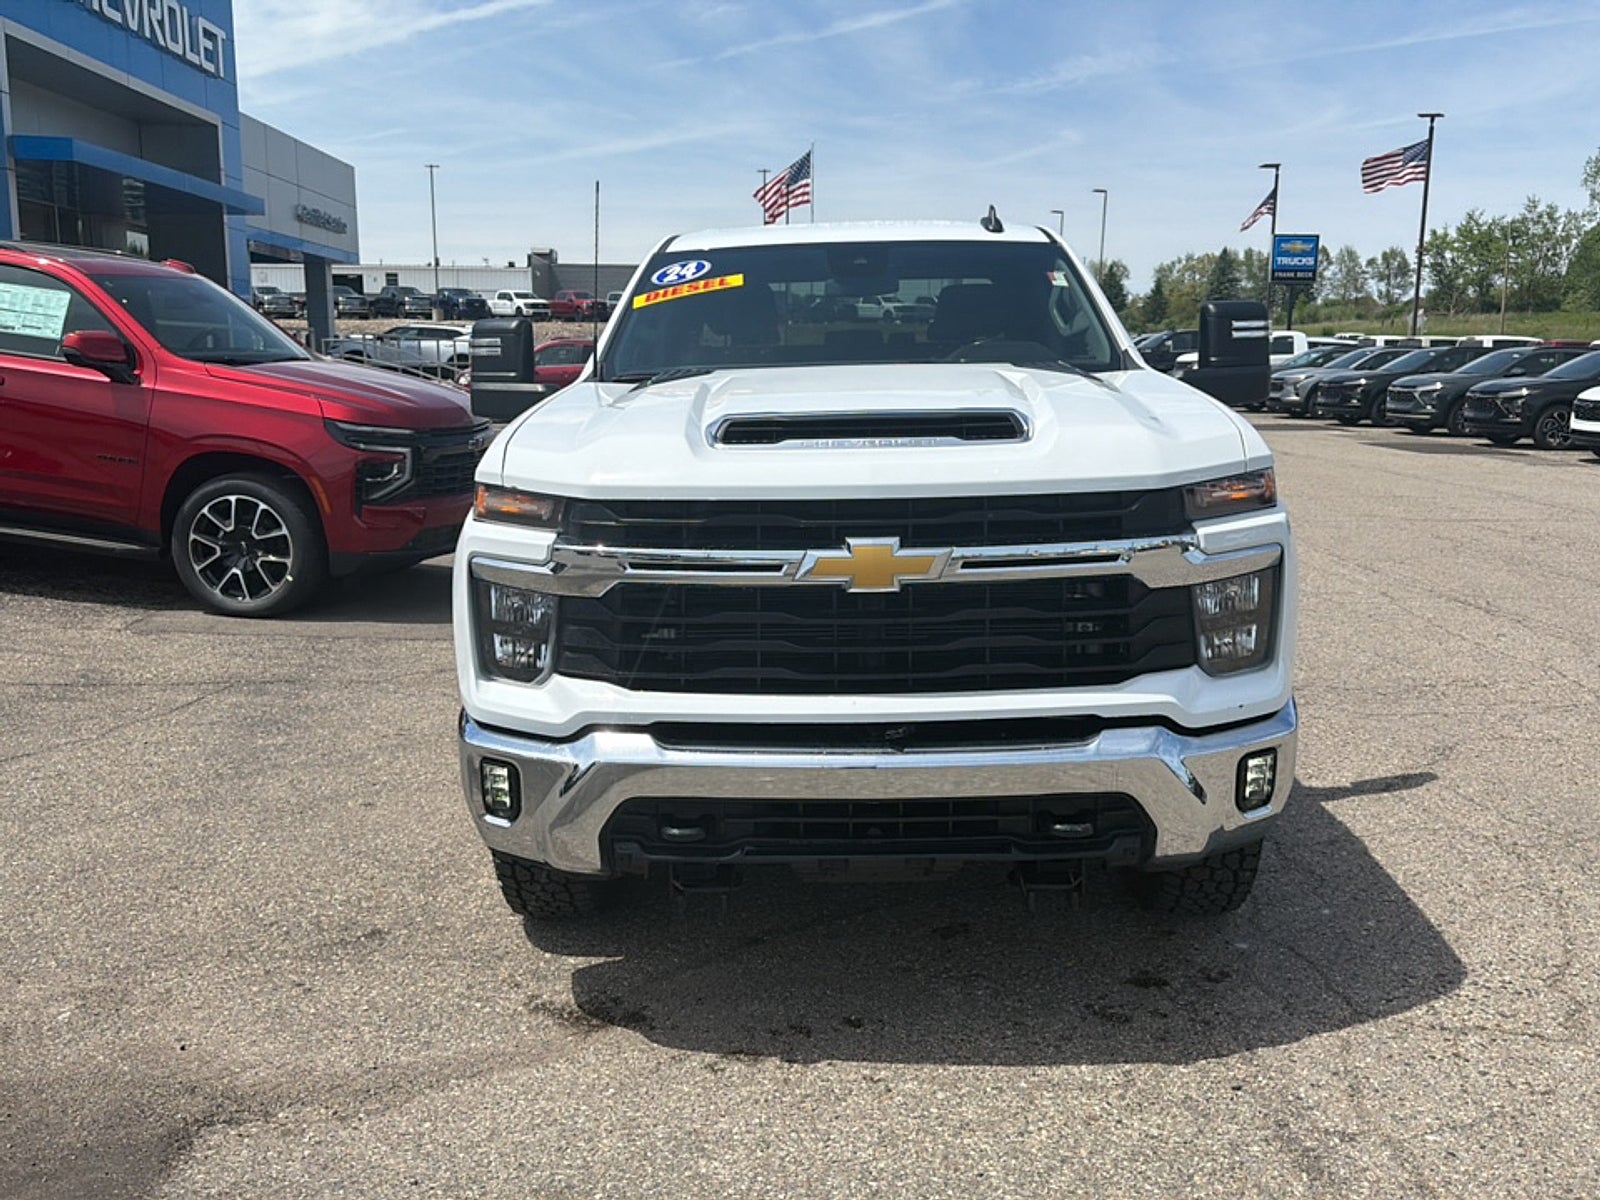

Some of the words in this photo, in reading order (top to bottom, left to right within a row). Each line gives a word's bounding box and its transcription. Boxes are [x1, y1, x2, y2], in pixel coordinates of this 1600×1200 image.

[80, 0, 225, 77] VROLET
[664, 260, 698, 283] 24
[1275, 256, 1315, 266] TRUCKS
[645, 277, 730, 303] DIESEL
